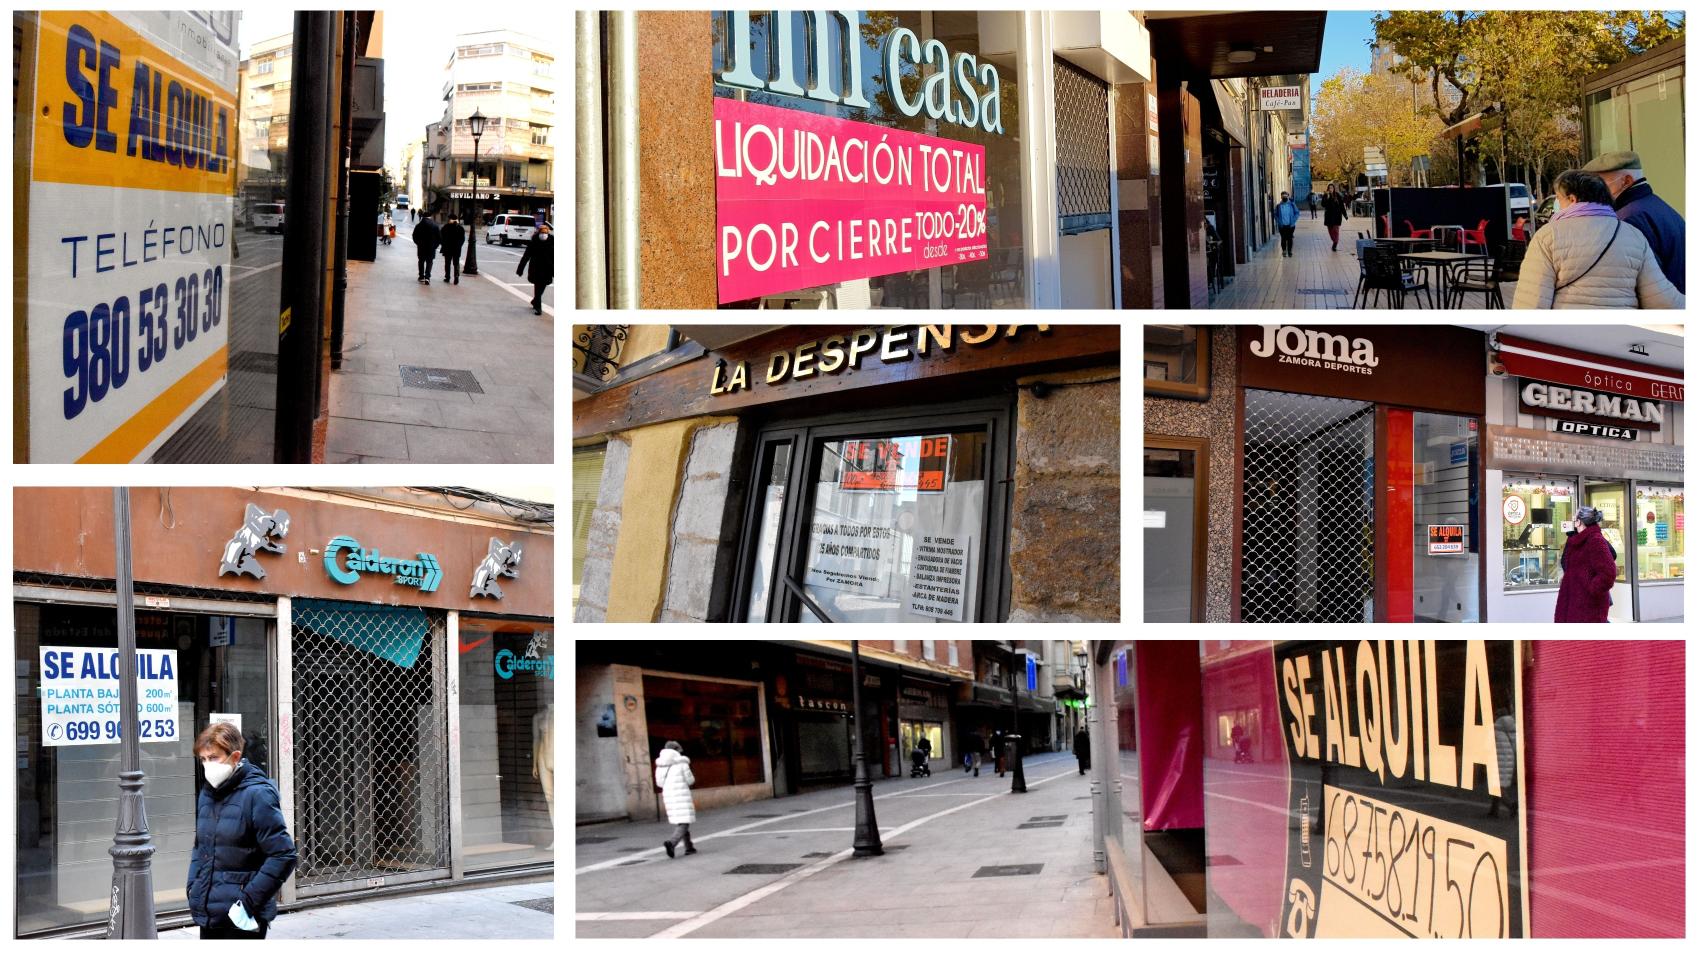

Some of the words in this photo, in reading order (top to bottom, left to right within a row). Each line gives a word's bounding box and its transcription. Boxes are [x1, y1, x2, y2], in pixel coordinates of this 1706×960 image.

[887, 27, 1004, 135] casa
[63, 24, 121, 154] SE
[127, 60, 229, 174] ALQUILA
[1262, 88, 1299, 98] HELADERIA
[715, 120, 912, 186] LIQUIDACIÓN
[920, 144, 985, 194] TOTAL
[61, 219, 225, 278] TELÉFONO
[722, 222, 799, 276] POR
[809, 218, 912, 264] CIERRE
[915, 211, 954, 240] TODO
[924, 240, 948, 259] desde
[63, 296, 130, 421] 980
[138, 282, 168, 373] 53
[174, 272, 199, 350] 30
[202, 265, 222, 333] 30
[1250, 324, 1379, 367] Joma
[1279, 355, 1321, 368] ZAMORA
[1324, 361, 1373, 375] DEPORTES
[710, 360, 747, 396] LA
[1584, 371, 1632, 391] óptica
[1522, 382, 1665, 423] GERMAN
[1562, 422, 1631, 439] OPTICA
[845, 442, 869, 461] SE
[878, 438, 948, 459] VENDE
[840, 524, 860, 537] TODOS
[860, 526, 871, 538] POR
[935, 537, 955, 545] VENDE
[1430, 526, 1438, 537] SE
[1439, 526, 1462, 538] ALQUILA
[324, 535, 424, 586] Calderon
[825, 541, 840, 556] AÑOS
[841, 545, 881, 560] COMPARTIDOS
[397, 575, 424, 587] SPORT
[837, 578, 863, 587] ZAMORA
[928, 593, 936, 601] DE
[936, 595, 959, 604] MADERA
[44, 651, 75, 679] SE
[81, 652, 174, 680] ALQILA
[495, 649, 550, 679] Calderon
[47, 688, 94, 699] PLANTA
[97, 688, 120, 699] BAJ
[798, 695, 847, 710] tascon
[47, 703, 94, 714] PLANTA
[97, 701, 143, 714] SÓTO
[1283, 654, 1320, 759] SE
[1322, 640, 1502, 797] ALQUILA
[66, 721, 100, 740] 699
[154, 719, 175, 738] 53
